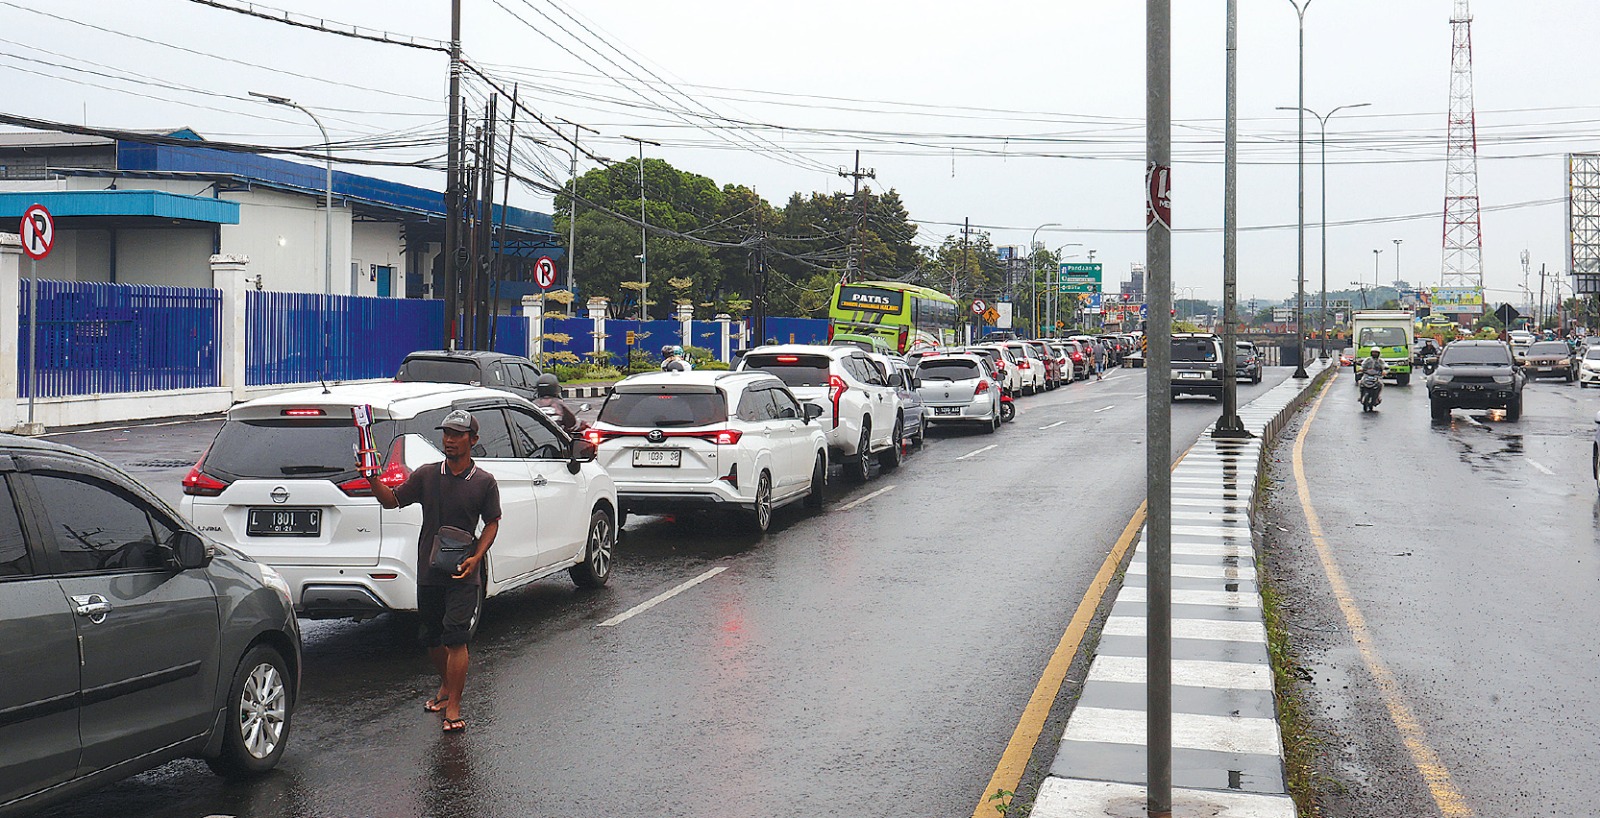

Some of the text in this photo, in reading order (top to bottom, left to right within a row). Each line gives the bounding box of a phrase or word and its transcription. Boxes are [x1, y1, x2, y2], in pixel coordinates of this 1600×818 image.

[852, 293, 890, 304] PATAS
[252, 512, 317, 525] L 1801 C
